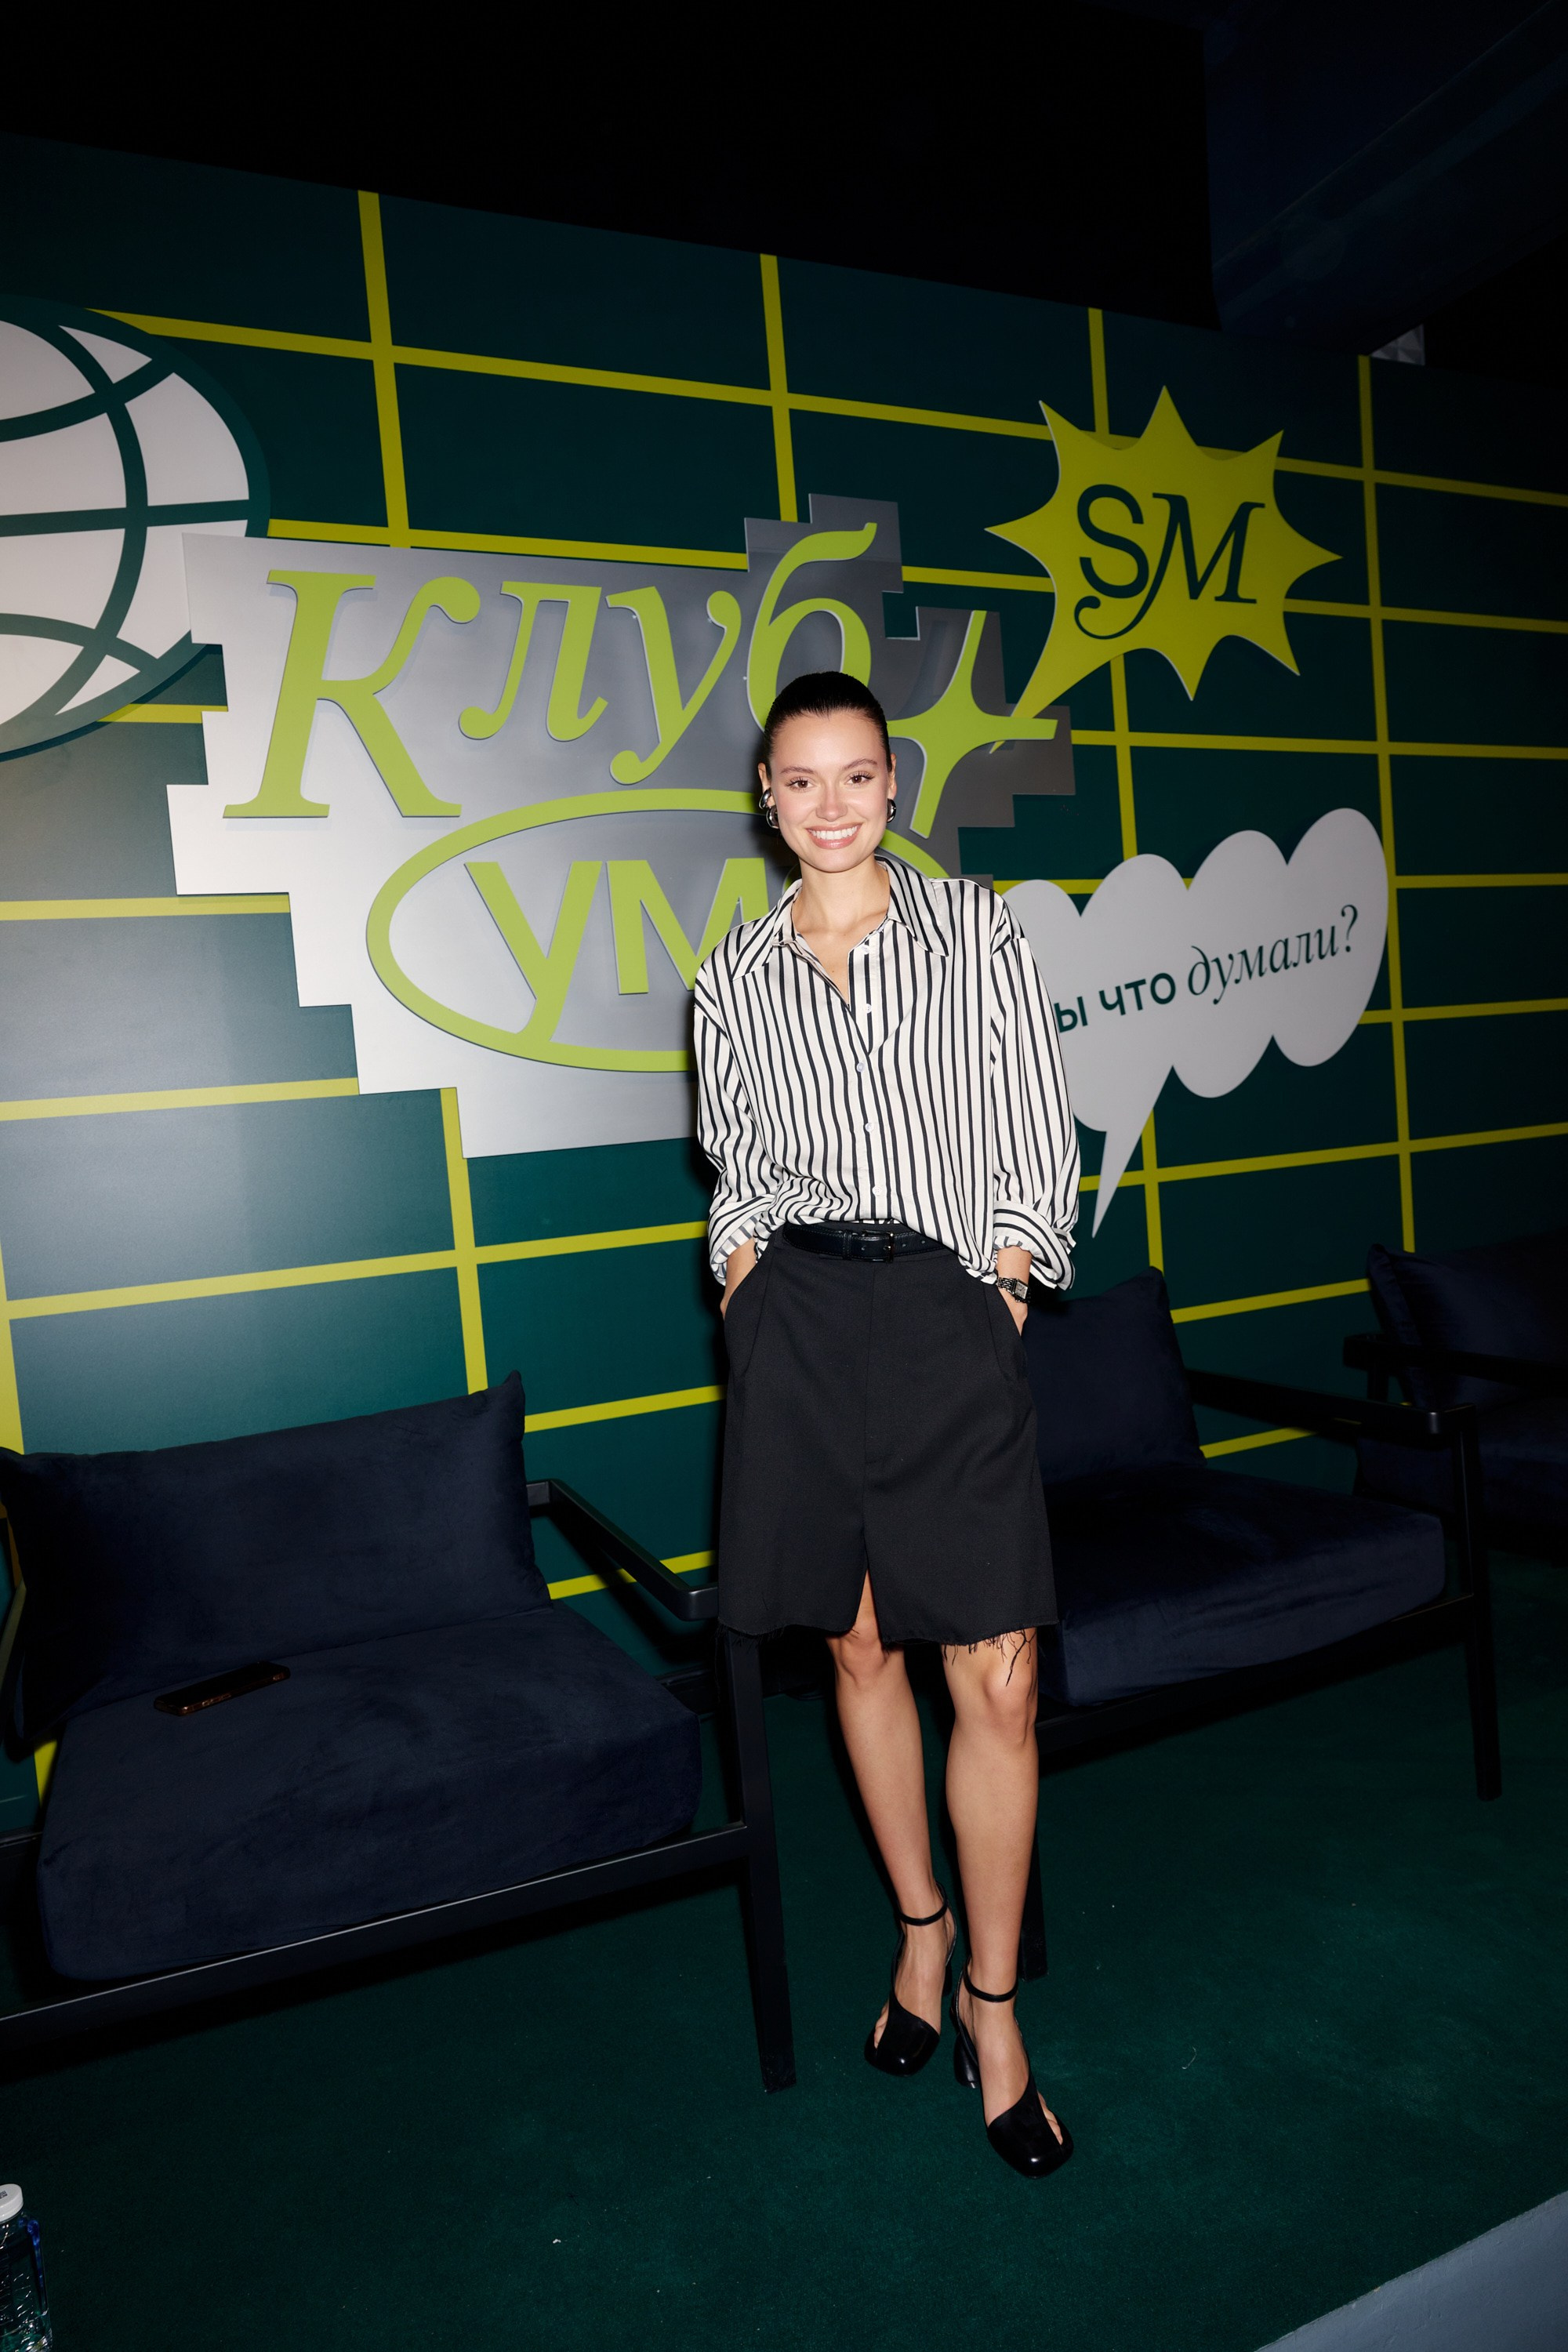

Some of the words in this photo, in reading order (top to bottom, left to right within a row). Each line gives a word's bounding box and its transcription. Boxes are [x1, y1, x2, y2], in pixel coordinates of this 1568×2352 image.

[1074, 484, 1265, 640] SM
[223, 521, 877, 818] Клуб
[464, 857, 801, 1043] ум
[1053, 996, 1088, 1033] ы
[1187, 904, 1359, 1005] думали?
